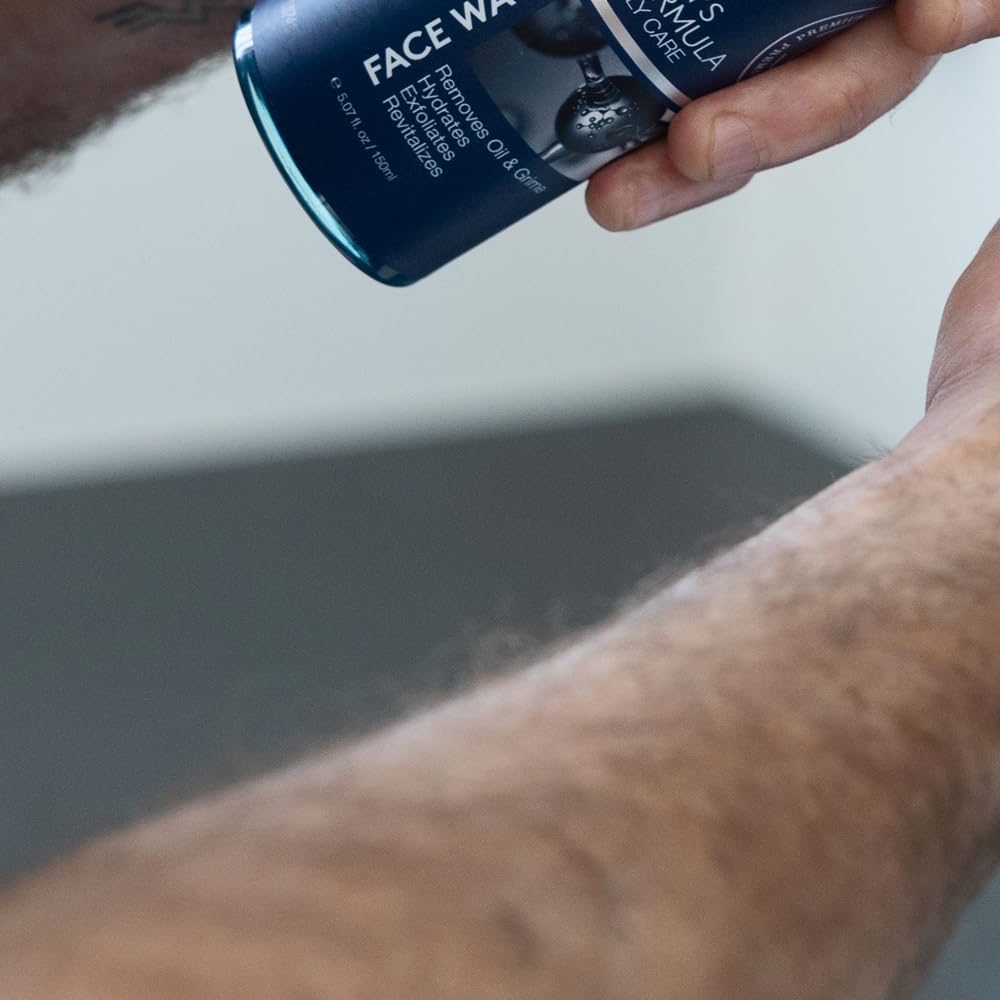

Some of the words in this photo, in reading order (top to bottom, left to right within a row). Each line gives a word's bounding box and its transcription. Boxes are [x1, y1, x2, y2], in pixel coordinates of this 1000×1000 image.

[363, 18, 452, 86] FACE
[643, 18, 686, 64] CARE
[337, 92, 357, 116] 5.07
[358, 130, 371, 144] oz
[372, 151, 398, 182] 150ml
[382, 94, 443, 177] Revitalizes
[400, 84, 455, 161] Exfoliates
[417, 74, 470, 147] Hydrates
[435, 64, 489, 139] Removes
[487, 139, 510, 160] Oil
[503, 158, 518, 171] &
[514, 168, 547, 194] Grime
